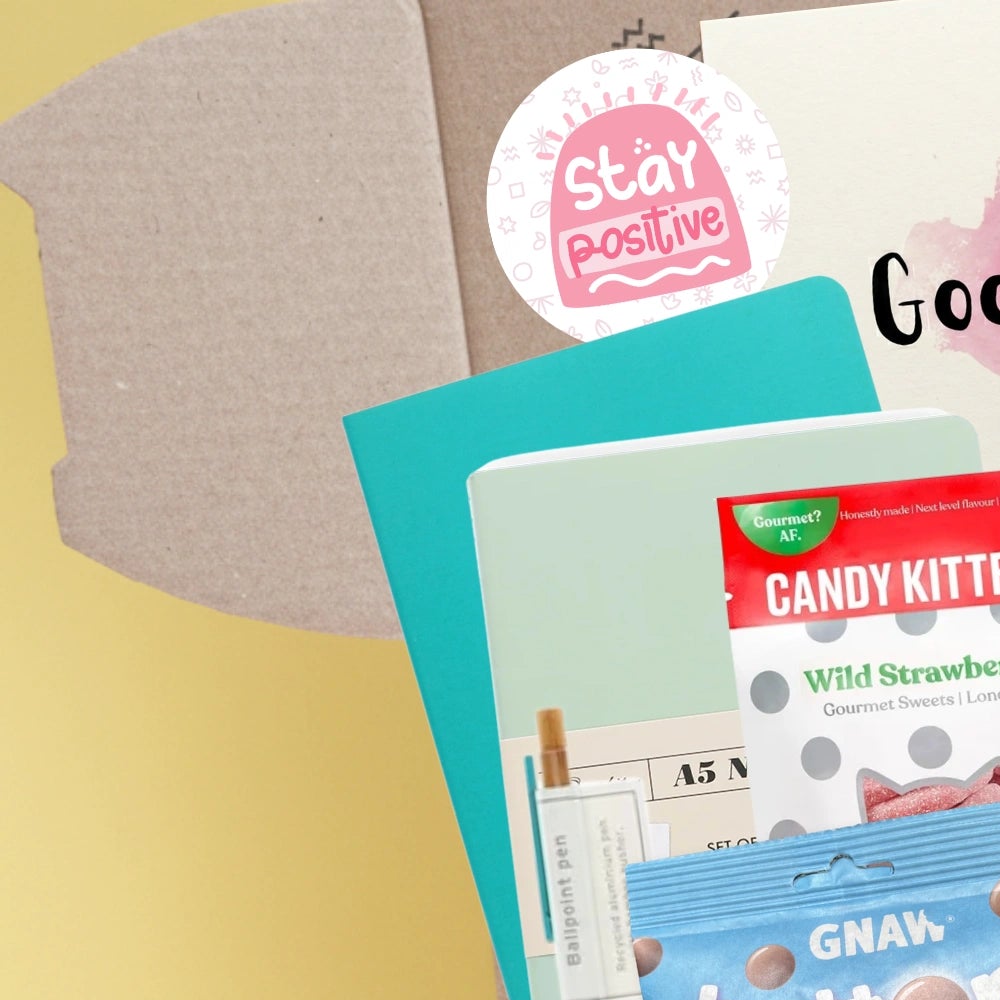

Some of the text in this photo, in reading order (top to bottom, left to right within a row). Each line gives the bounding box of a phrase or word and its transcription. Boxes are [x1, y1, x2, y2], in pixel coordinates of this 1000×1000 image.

[566, 205, 724, 278] positive
[753, 509, 822, 529] Gourmet?
[840, 508, 883, 521] Honestly
[883, 504, 910, 516] made
[915, 503, 938, 513] Next
[939, 500, 960, 512] level
[962, 499, 996, 509] flavour
[779, 529, 802, 543] AF.
[765, 562, 892, 617] CANDY
[803, 663, 873, 694] Wild
[823, 699, 895, 717] Gourmet
[898, 693, 955, 710] Sweets
[673, 759, 716, 788] A5
[707, 840, 731, 851] SET
[553, 834, 582, 967] Ballpoint pen
[809, 909, 945, 960] GNAW
